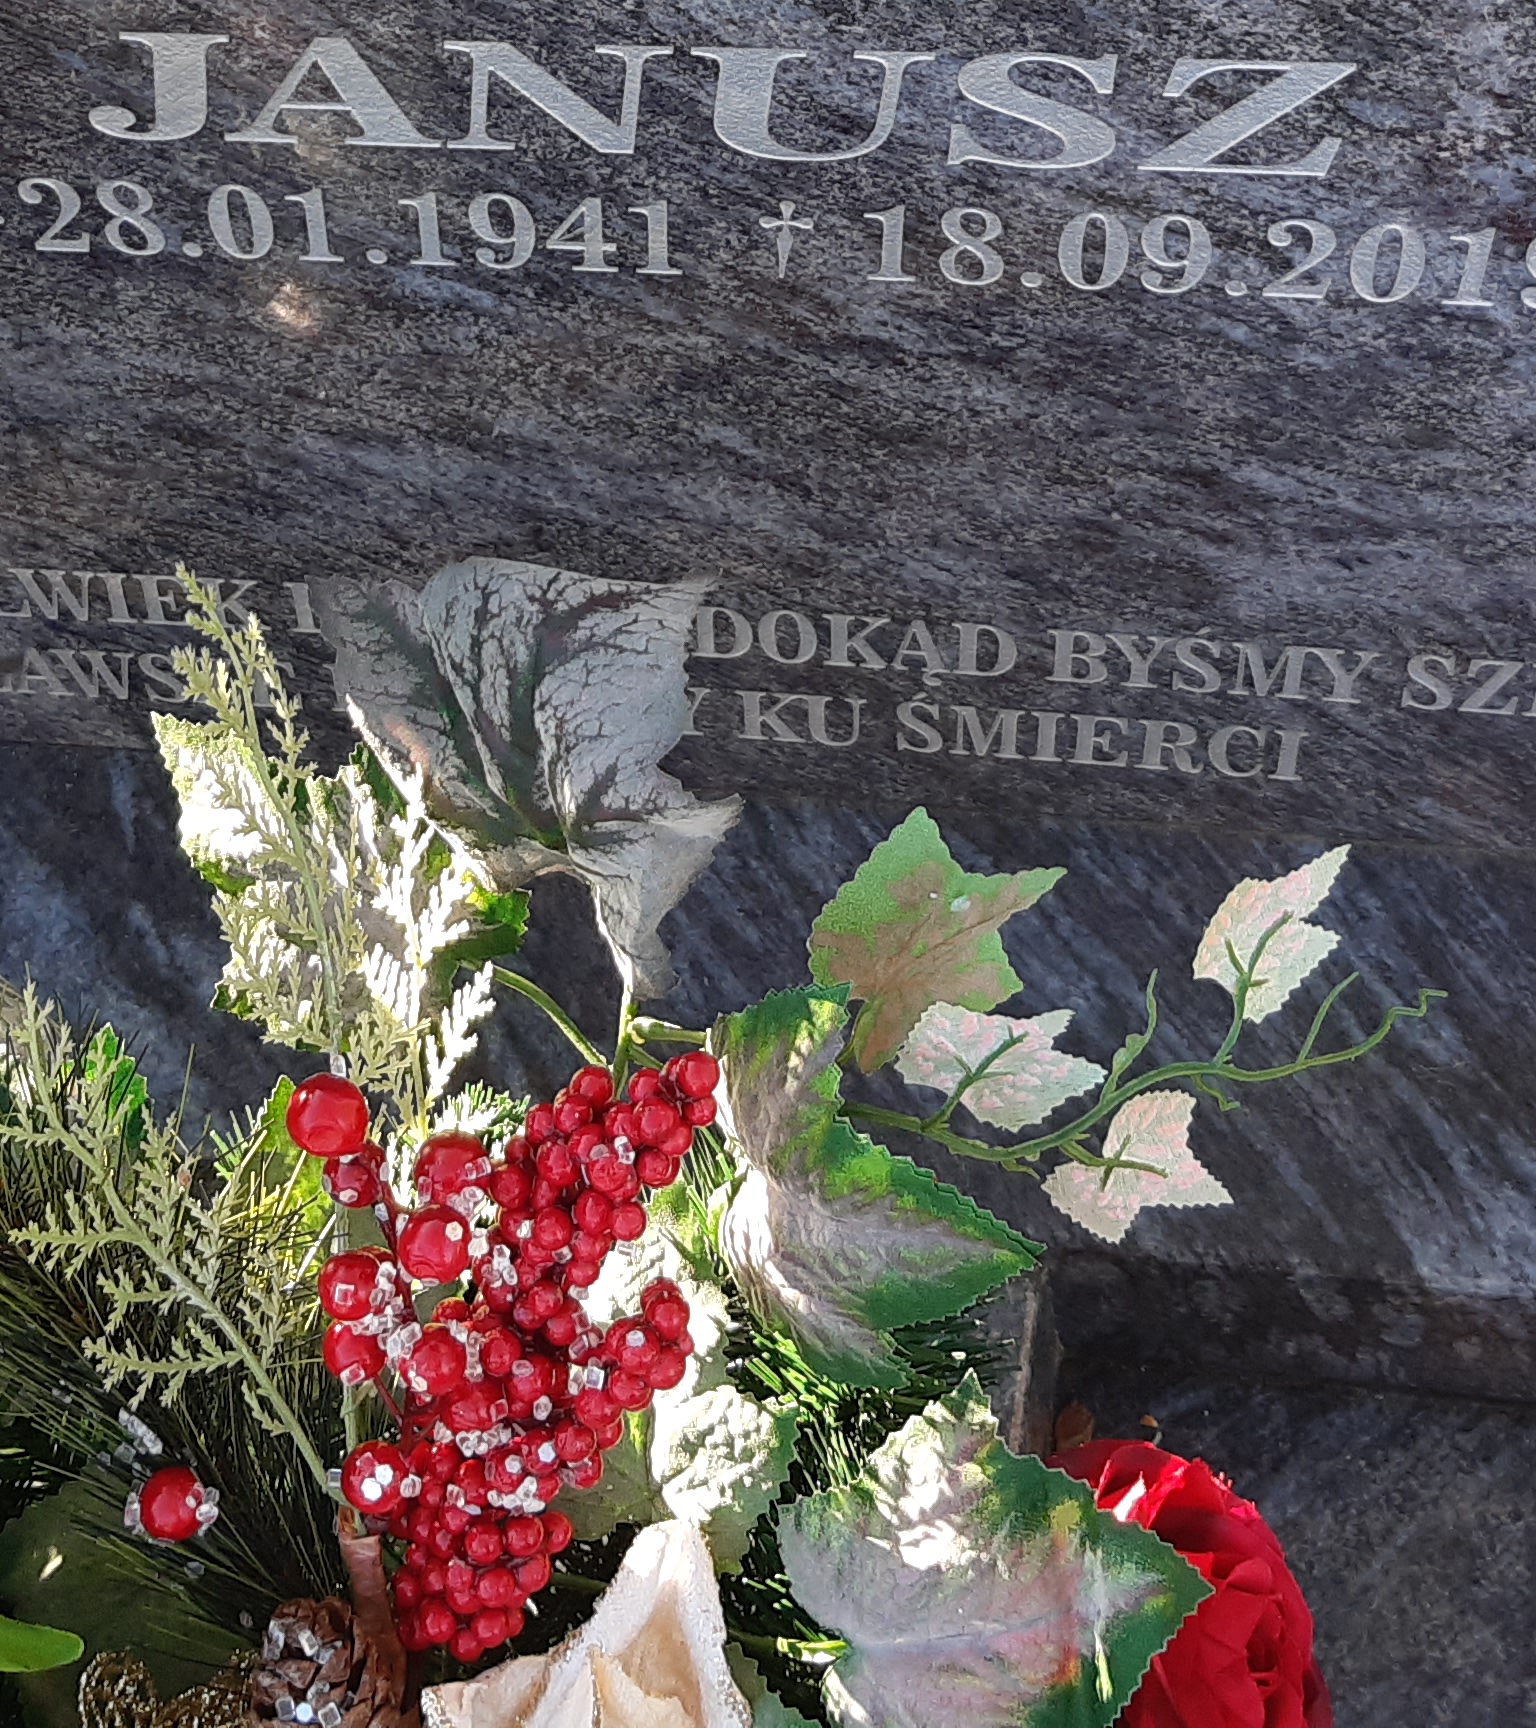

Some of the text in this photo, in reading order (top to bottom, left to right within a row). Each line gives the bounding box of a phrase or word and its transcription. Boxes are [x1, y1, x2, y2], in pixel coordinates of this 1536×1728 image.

[89, 32, 1357, 177] JANUSZ
[691, 606, 1018, 686] DOKĄD
[1046, 627, 1382, 704] BYŚMY
[735, 689, 868, 747] KU
[895, 691, 1309, 782] ŚMIERCI
